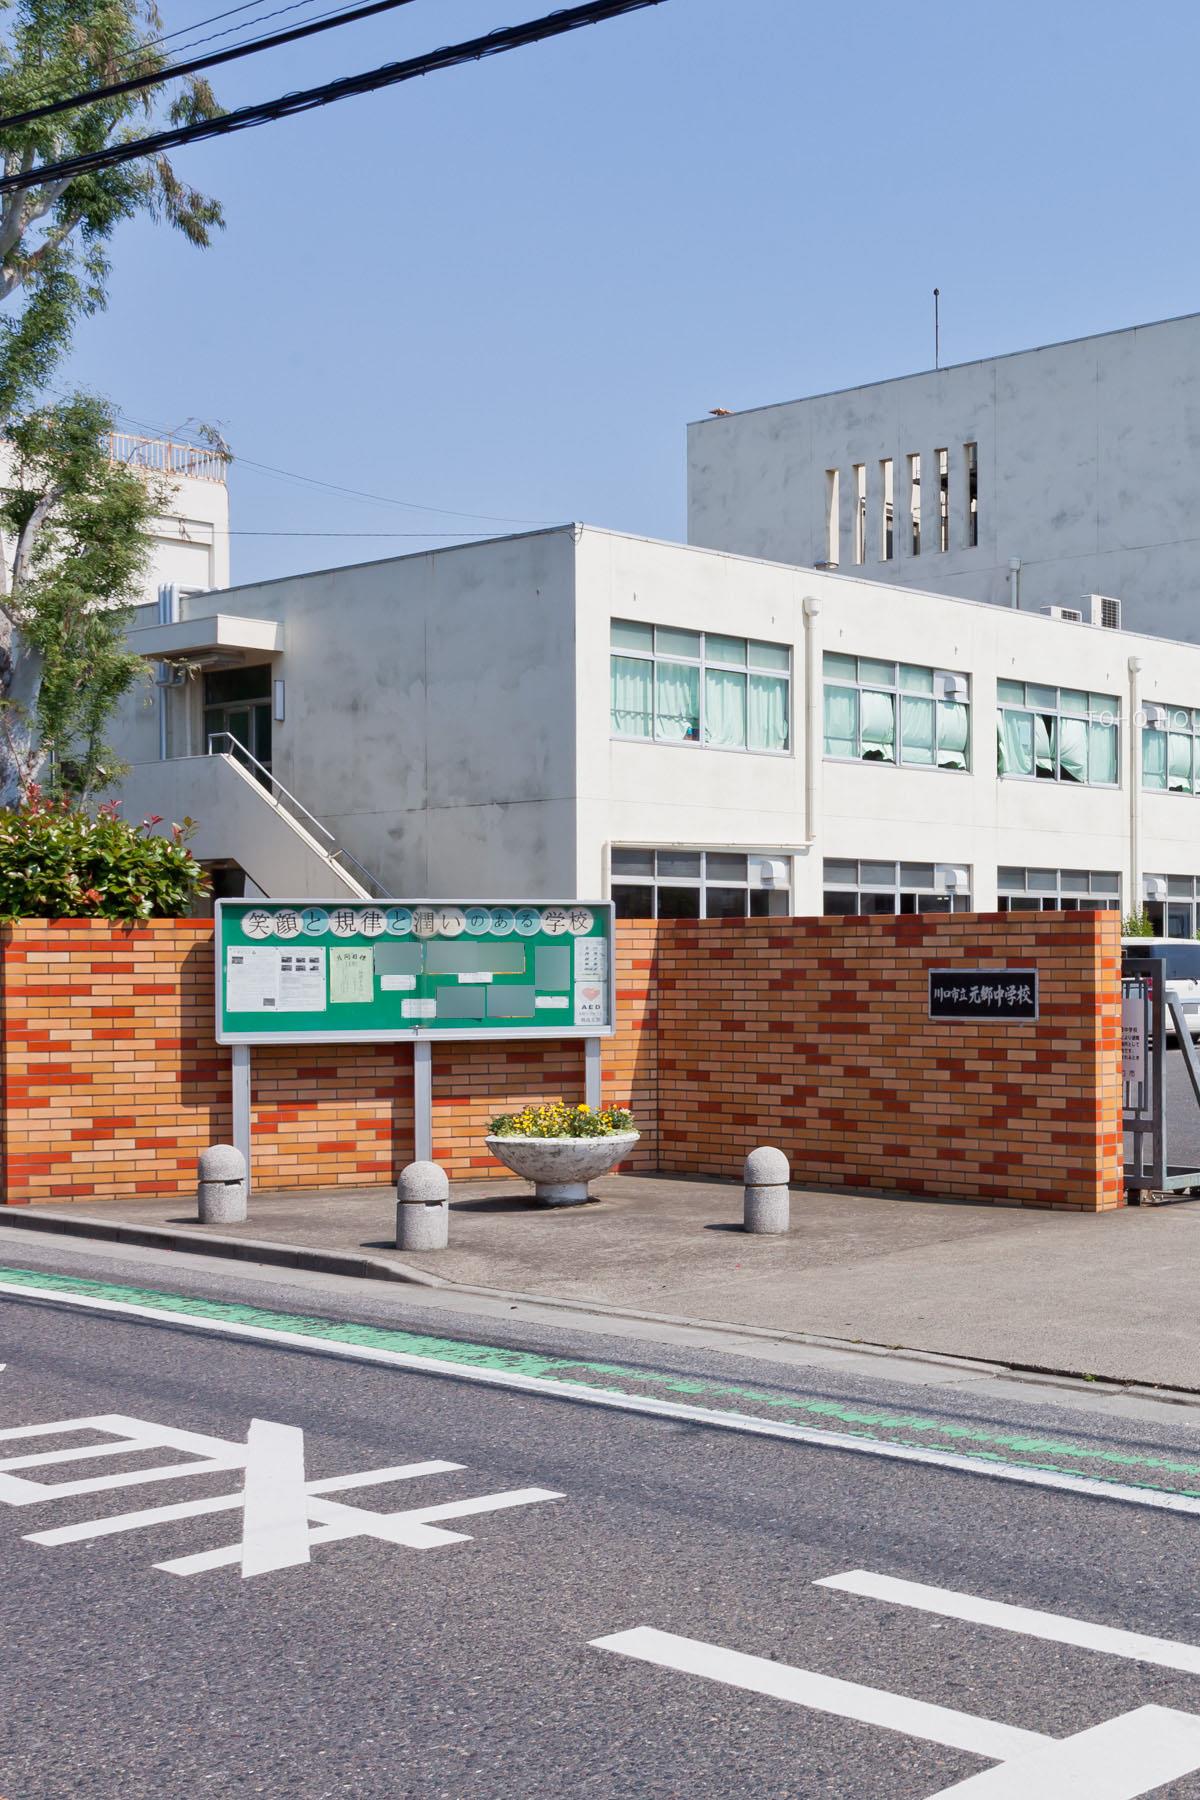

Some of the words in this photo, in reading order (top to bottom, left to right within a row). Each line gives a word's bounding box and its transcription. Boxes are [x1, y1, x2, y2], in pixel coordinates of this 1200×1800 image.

[248, 910, 589, 937] 笑顔と規律と潤いのある学校
[934, 984, 1033, 1008] 川口市立元郷中学校
